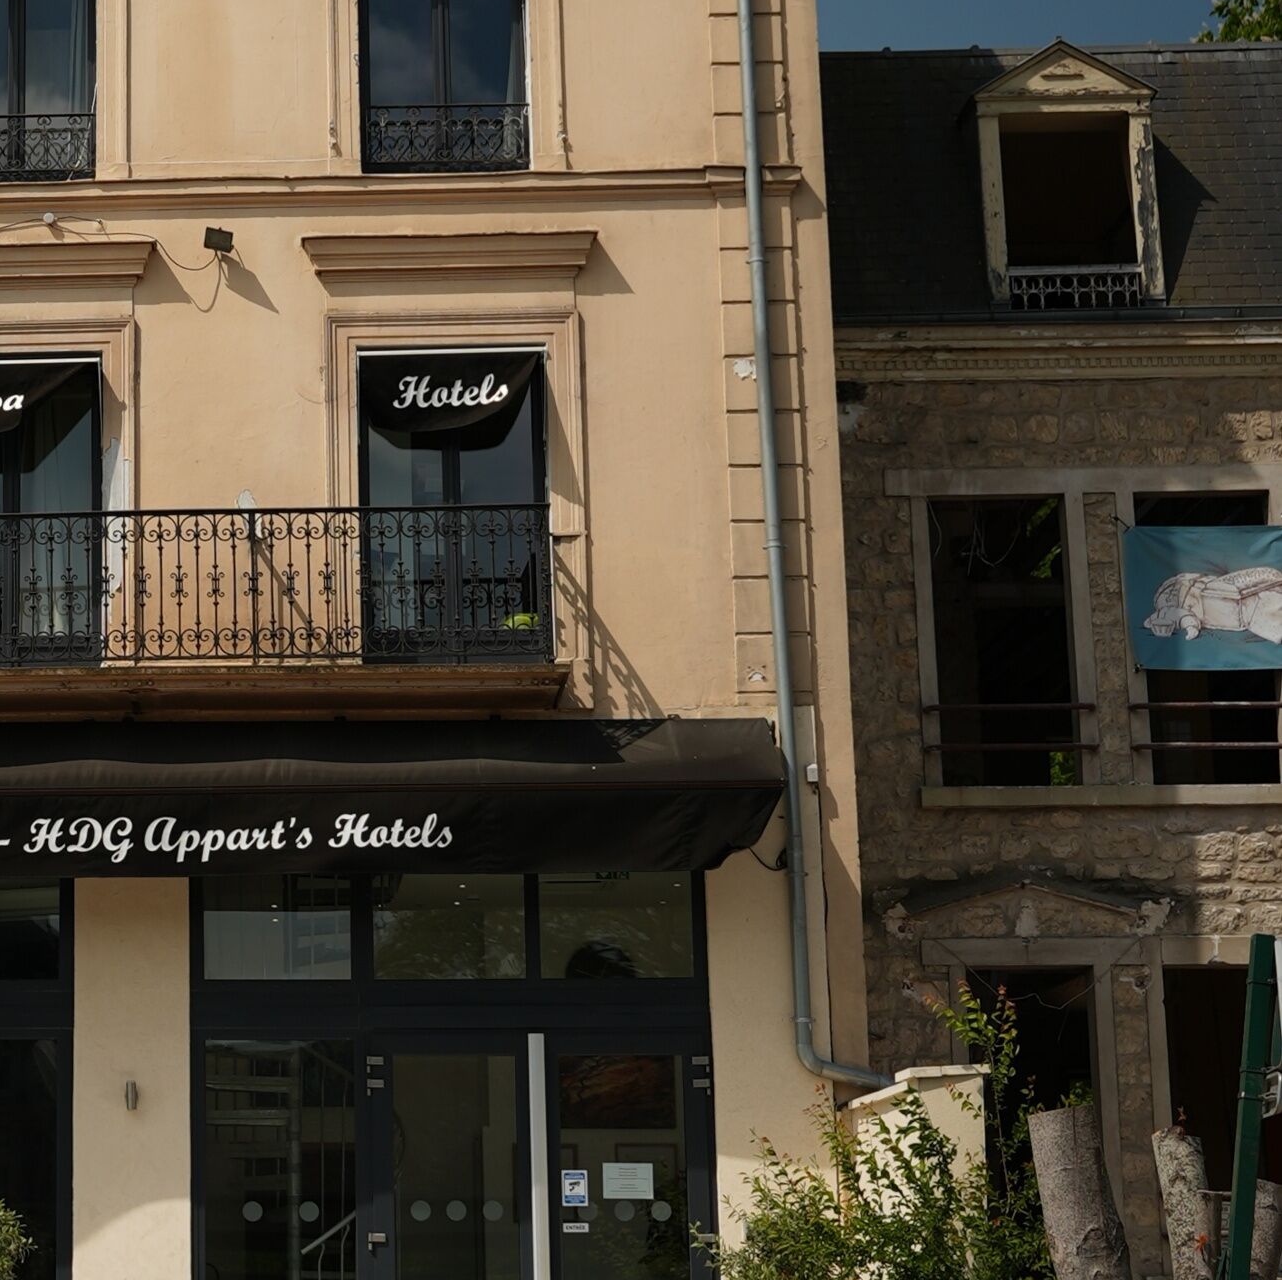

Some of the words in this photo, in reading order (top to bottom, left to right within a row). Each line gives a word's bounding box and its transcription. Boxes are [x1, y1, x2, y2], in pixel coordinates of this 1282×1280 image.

[392, 373, 509, 409] Hotels
[22, 816, 134, 864] HDG
[144, 816, 313, 863] Appart's
[327, 812, 453, 849] Hotels
